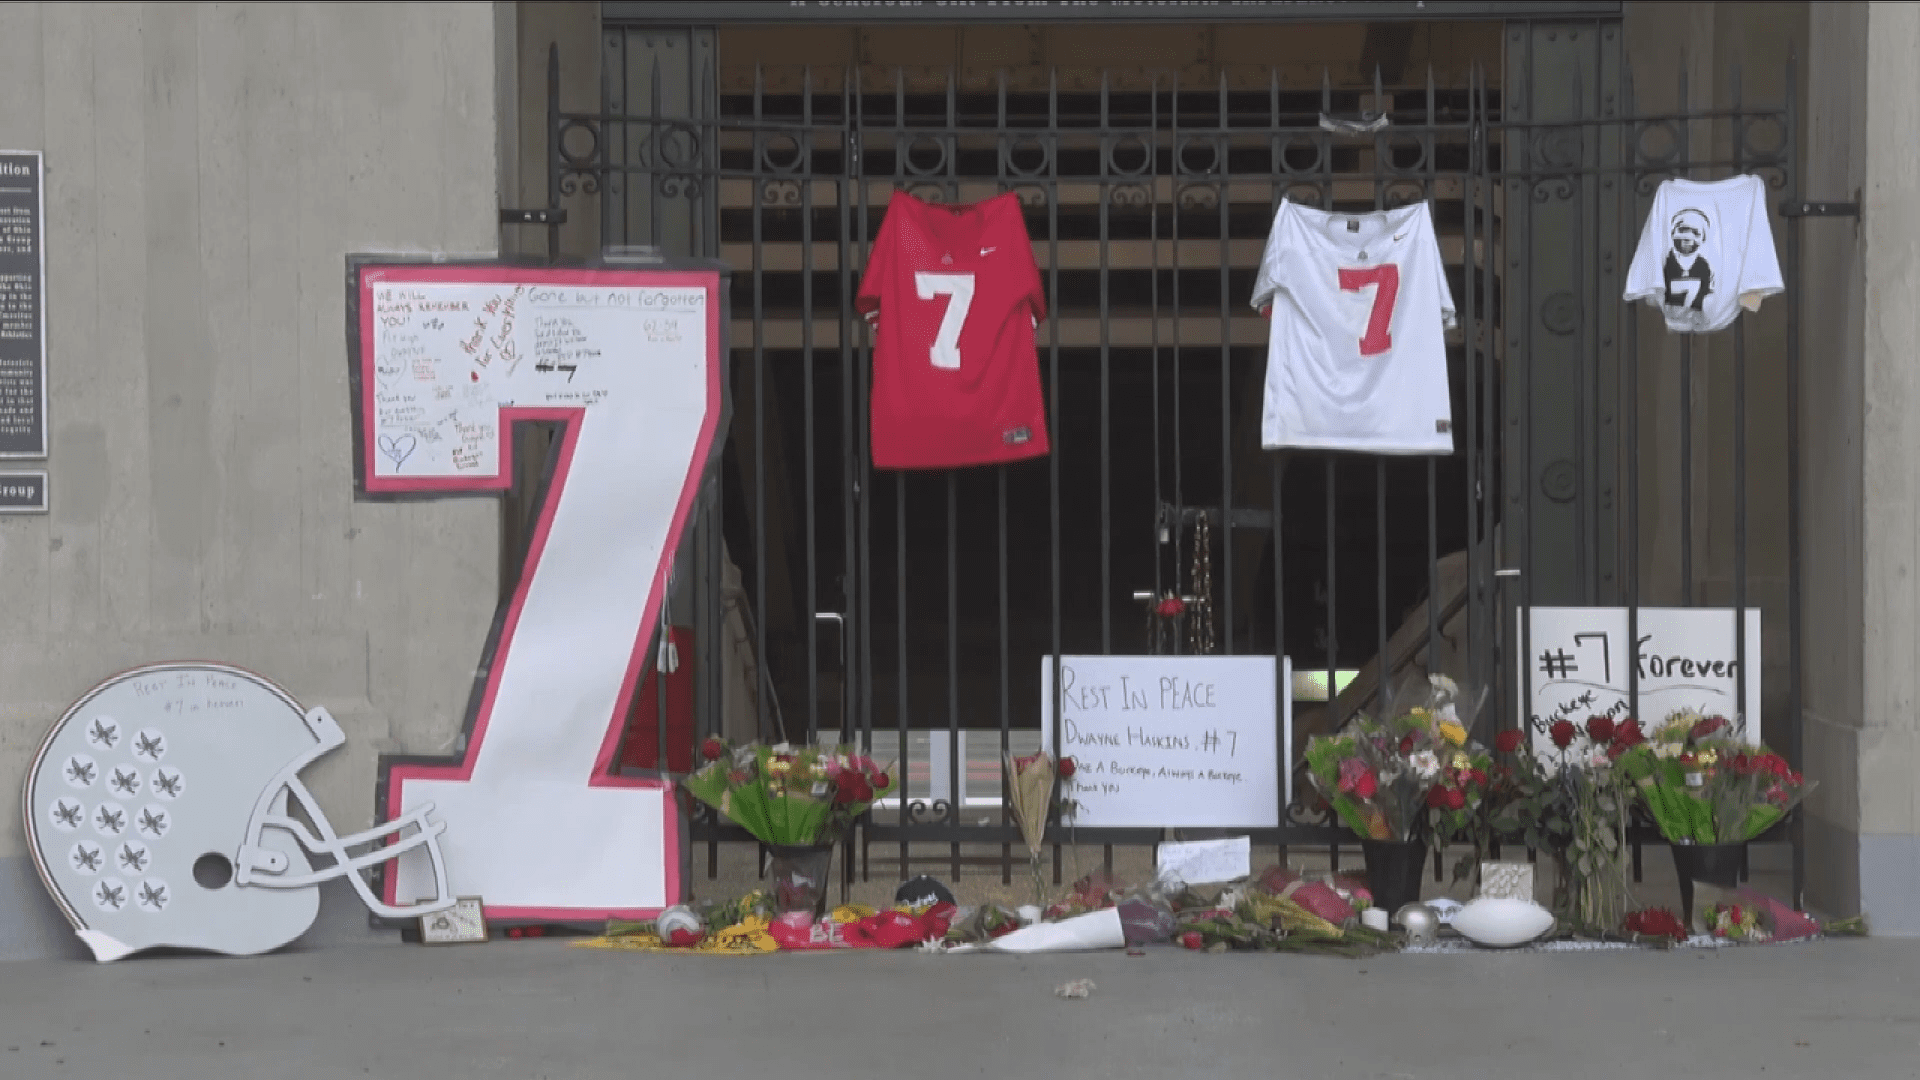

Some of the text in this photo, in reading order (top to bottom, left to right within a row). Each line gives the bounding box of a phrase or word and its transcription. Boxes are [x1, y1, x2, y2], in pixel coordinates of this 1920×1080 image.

[528, 287, 568, 303] Gone
[575, 291, 600, 304] but
[607, 292, 632, 306] not
[914, 271, 976, 370] 7
[1338, 263, 1400, 357] 7
[1671, 279, 1701, 309] 7
[360, 266, 719, 920] 7
[1538, 631, 1611, 685] #7
[1120, 676, 1148, 711] IN
[1159, 676, 1217, 710] PEACE
